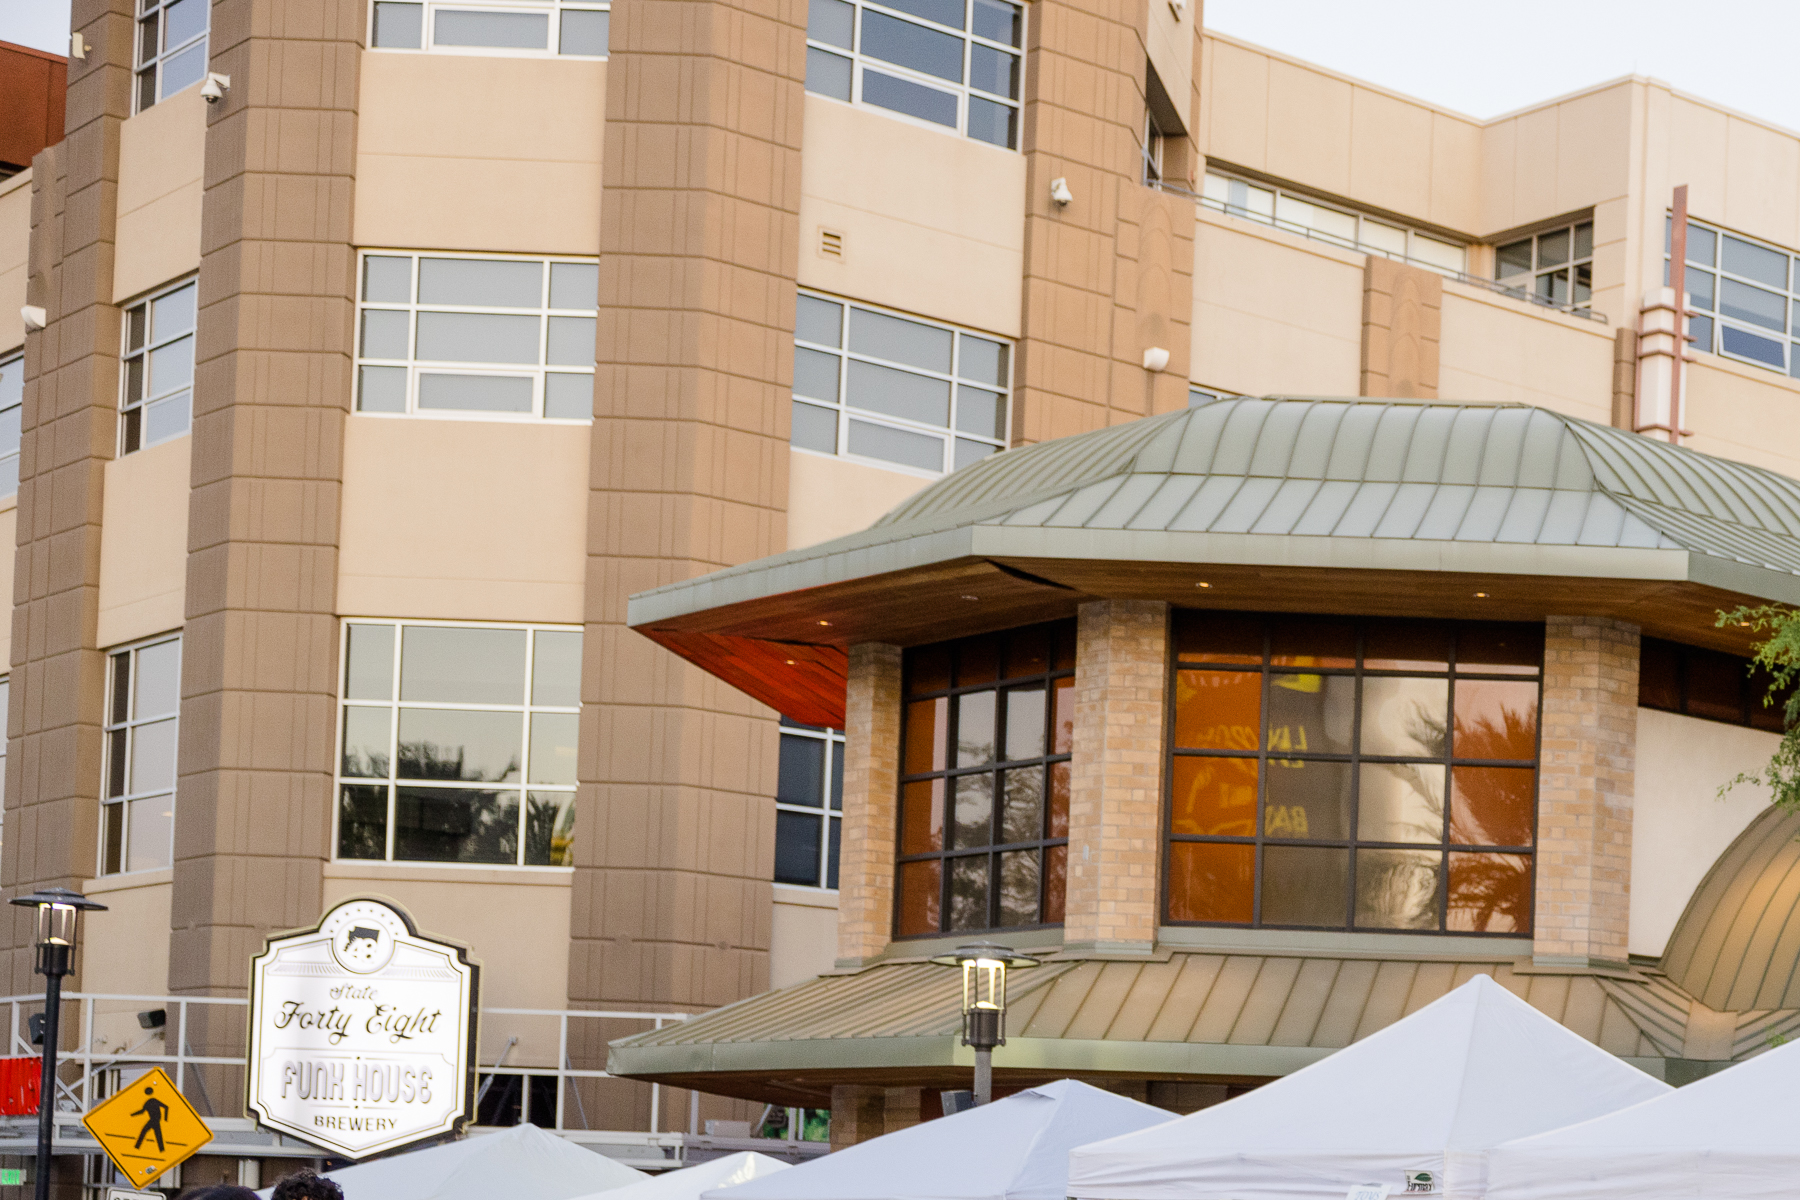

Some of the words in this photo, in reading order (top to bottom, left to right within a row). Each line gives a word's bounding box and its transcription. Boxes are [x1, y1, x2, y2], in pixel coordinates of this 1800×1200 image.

[330, 983, 378, 1000] State
[274, 1000, 353, 1045] Forty
[366, 1002, 442, 1044] Eight
[281, 1060, 344, 1101] FUNK
[353, 1063, 433, 1104] HOUSE
[314, 1116, 398, 1132] BREWERY
[2, 1169, 20, 1184] EXIT
